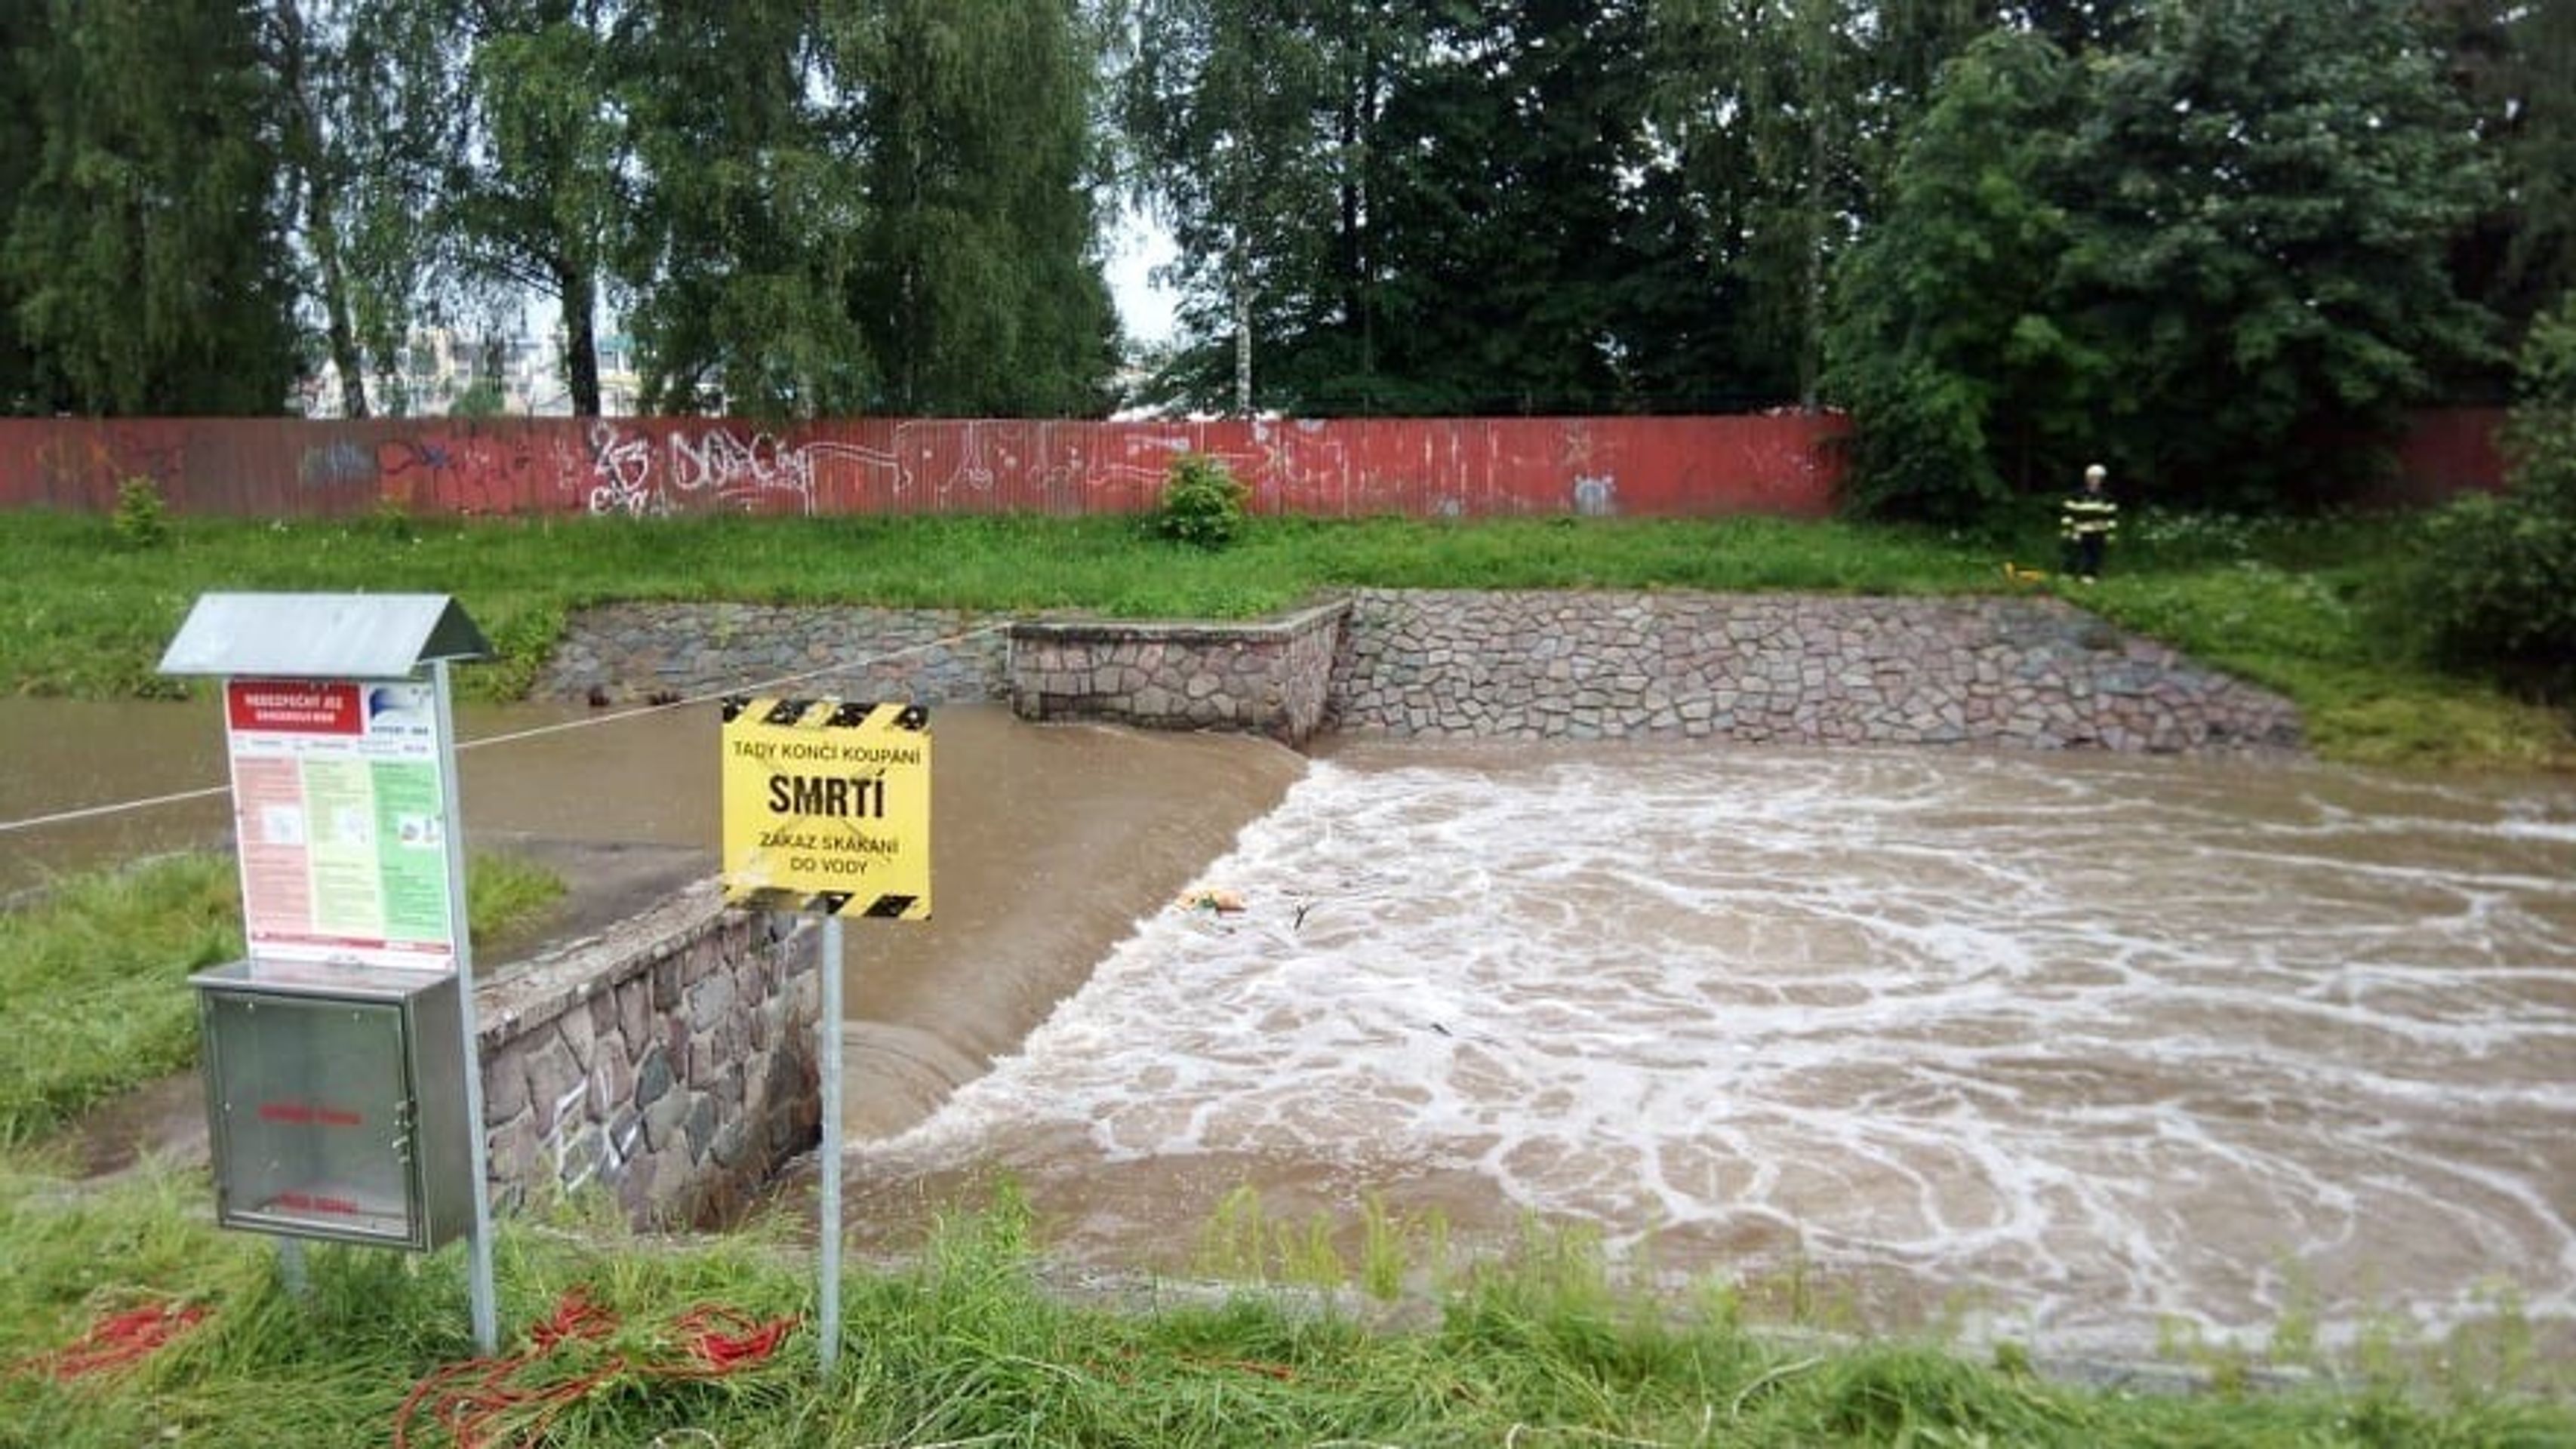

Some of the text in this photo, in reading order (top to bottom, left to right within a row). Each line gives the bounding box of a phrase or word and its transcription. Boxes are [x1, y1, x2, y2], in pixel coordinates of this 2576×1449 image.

[732, 740, 777, 758] TADY
[768, 768, 886, 818] SMRTÍ
[789, 857, 868, 875] DO VODY
